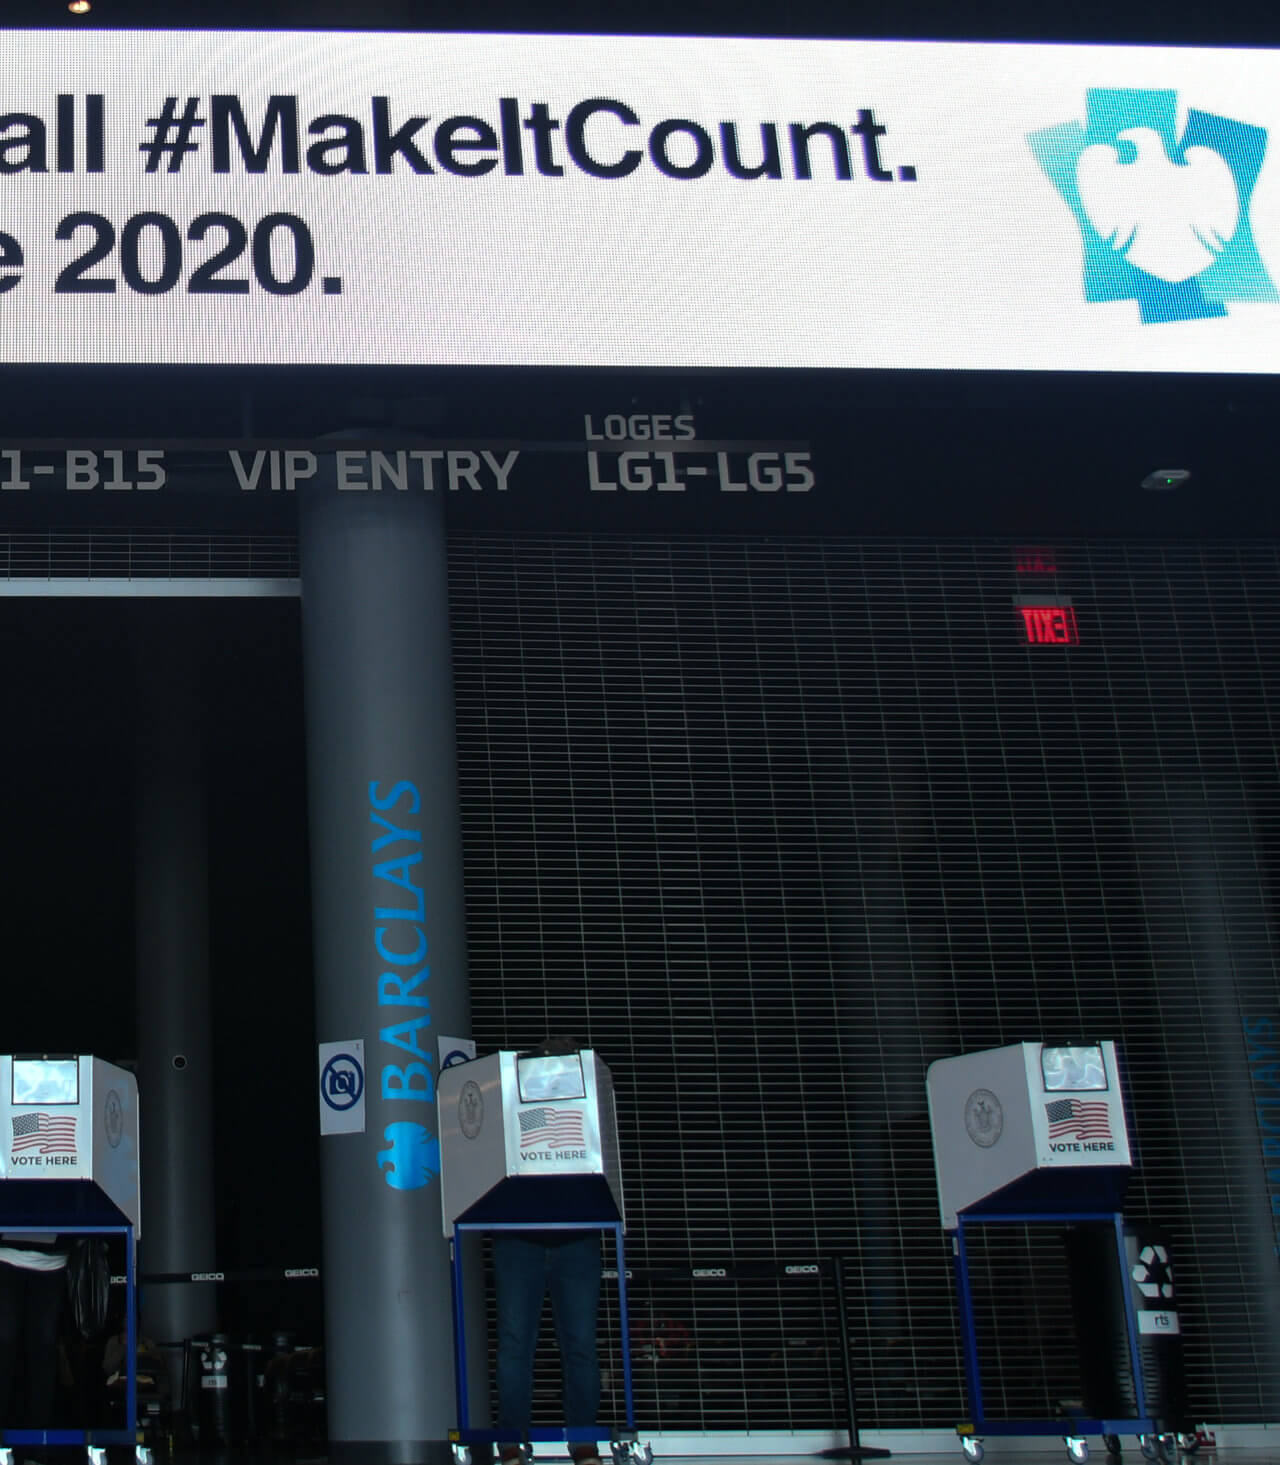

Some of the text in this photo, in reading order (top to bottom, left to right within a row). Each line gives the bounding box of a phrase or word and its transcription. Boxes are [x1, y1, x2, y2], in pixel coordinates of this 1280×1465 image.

[138, 94, 918, 182] #MakeItCount.
[54, 211, 343, 296] 2020.
[584, 413, 697, 442] LOGES
[228, 450, 318, 491] VIP
[335, 450, 521, 492] ENTRY
[586, 452, 816, 493] LG1-LG5
[369, 780, 435, 1104] BARCLAYS
[520, 1149, 587, 1161] VOTE HERE
[1048, 1141, 1115, 1153] VOTE HERE
[11, 1156, 78, 1166] VOTE HERE
[191, 1271, 225, 1282] GEICO
[284, 1267, 320, 1278] GEICO
